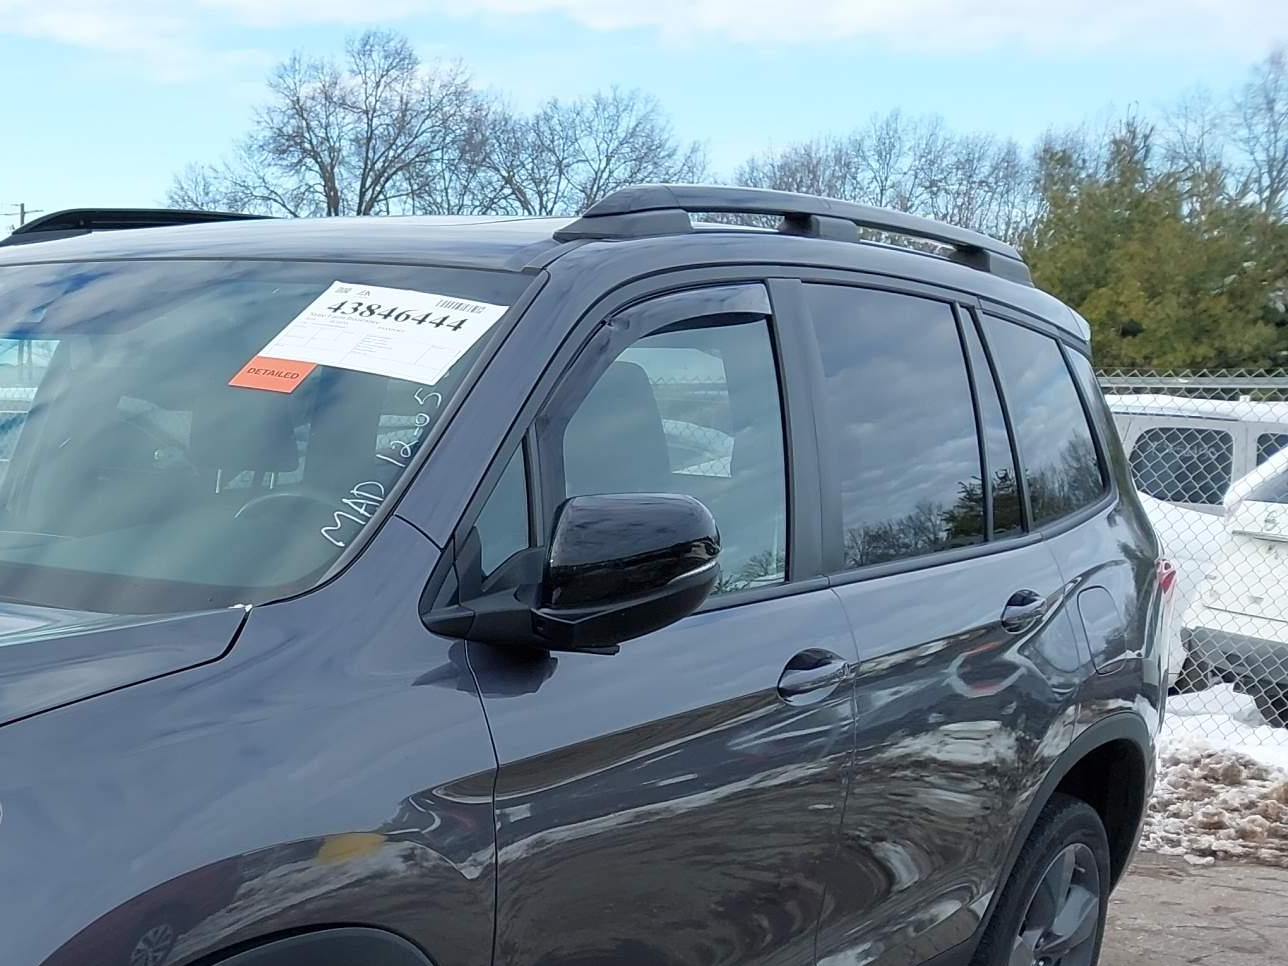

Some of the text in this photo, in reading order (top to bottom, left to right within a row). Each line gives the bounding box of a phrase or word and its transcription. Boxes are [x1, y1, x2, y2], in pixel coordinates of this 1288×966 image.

[327, 300, 468, 332] 43846444
[246, 366, 300, 381] DETAILED
[320, 479, 386, 547] MAD
[374, 386, 443, 468] 12-05
